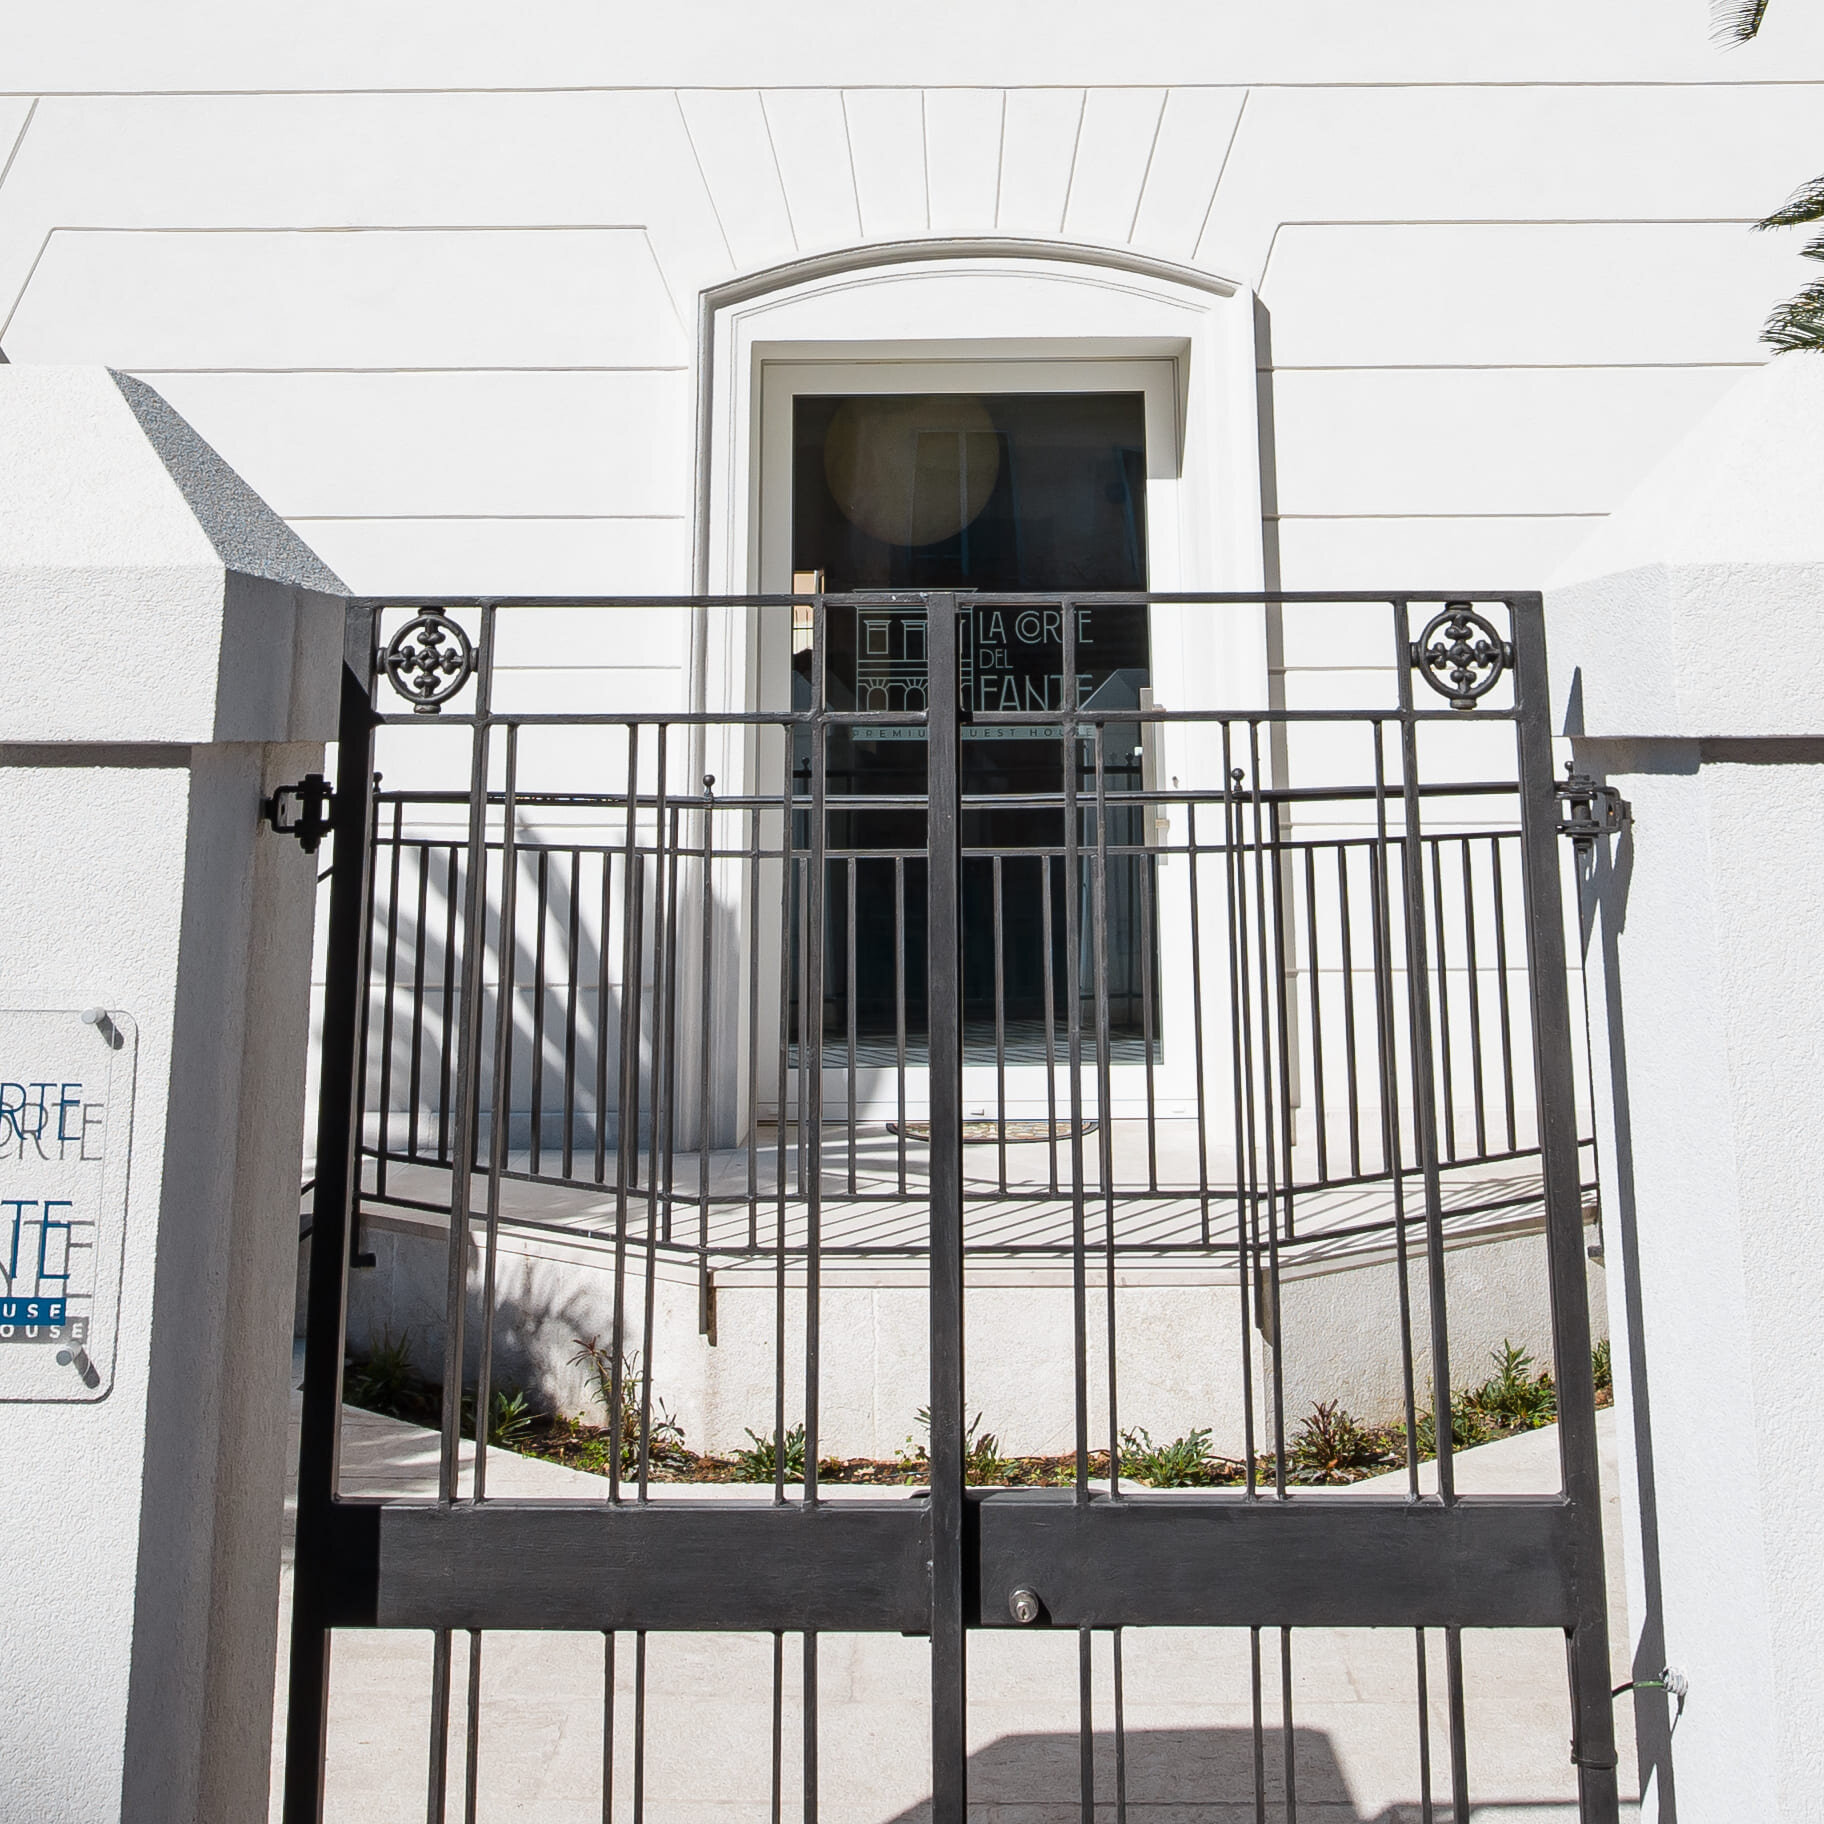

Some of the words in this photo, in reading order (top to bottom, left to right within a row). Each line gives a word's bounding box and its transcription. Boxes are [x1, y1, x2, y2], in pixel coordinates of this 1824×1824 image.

[979, 610, 1007, 644] LA
[1015, 610, 1094, 644] CORE
[979, 648, 1014, 669] DEL
